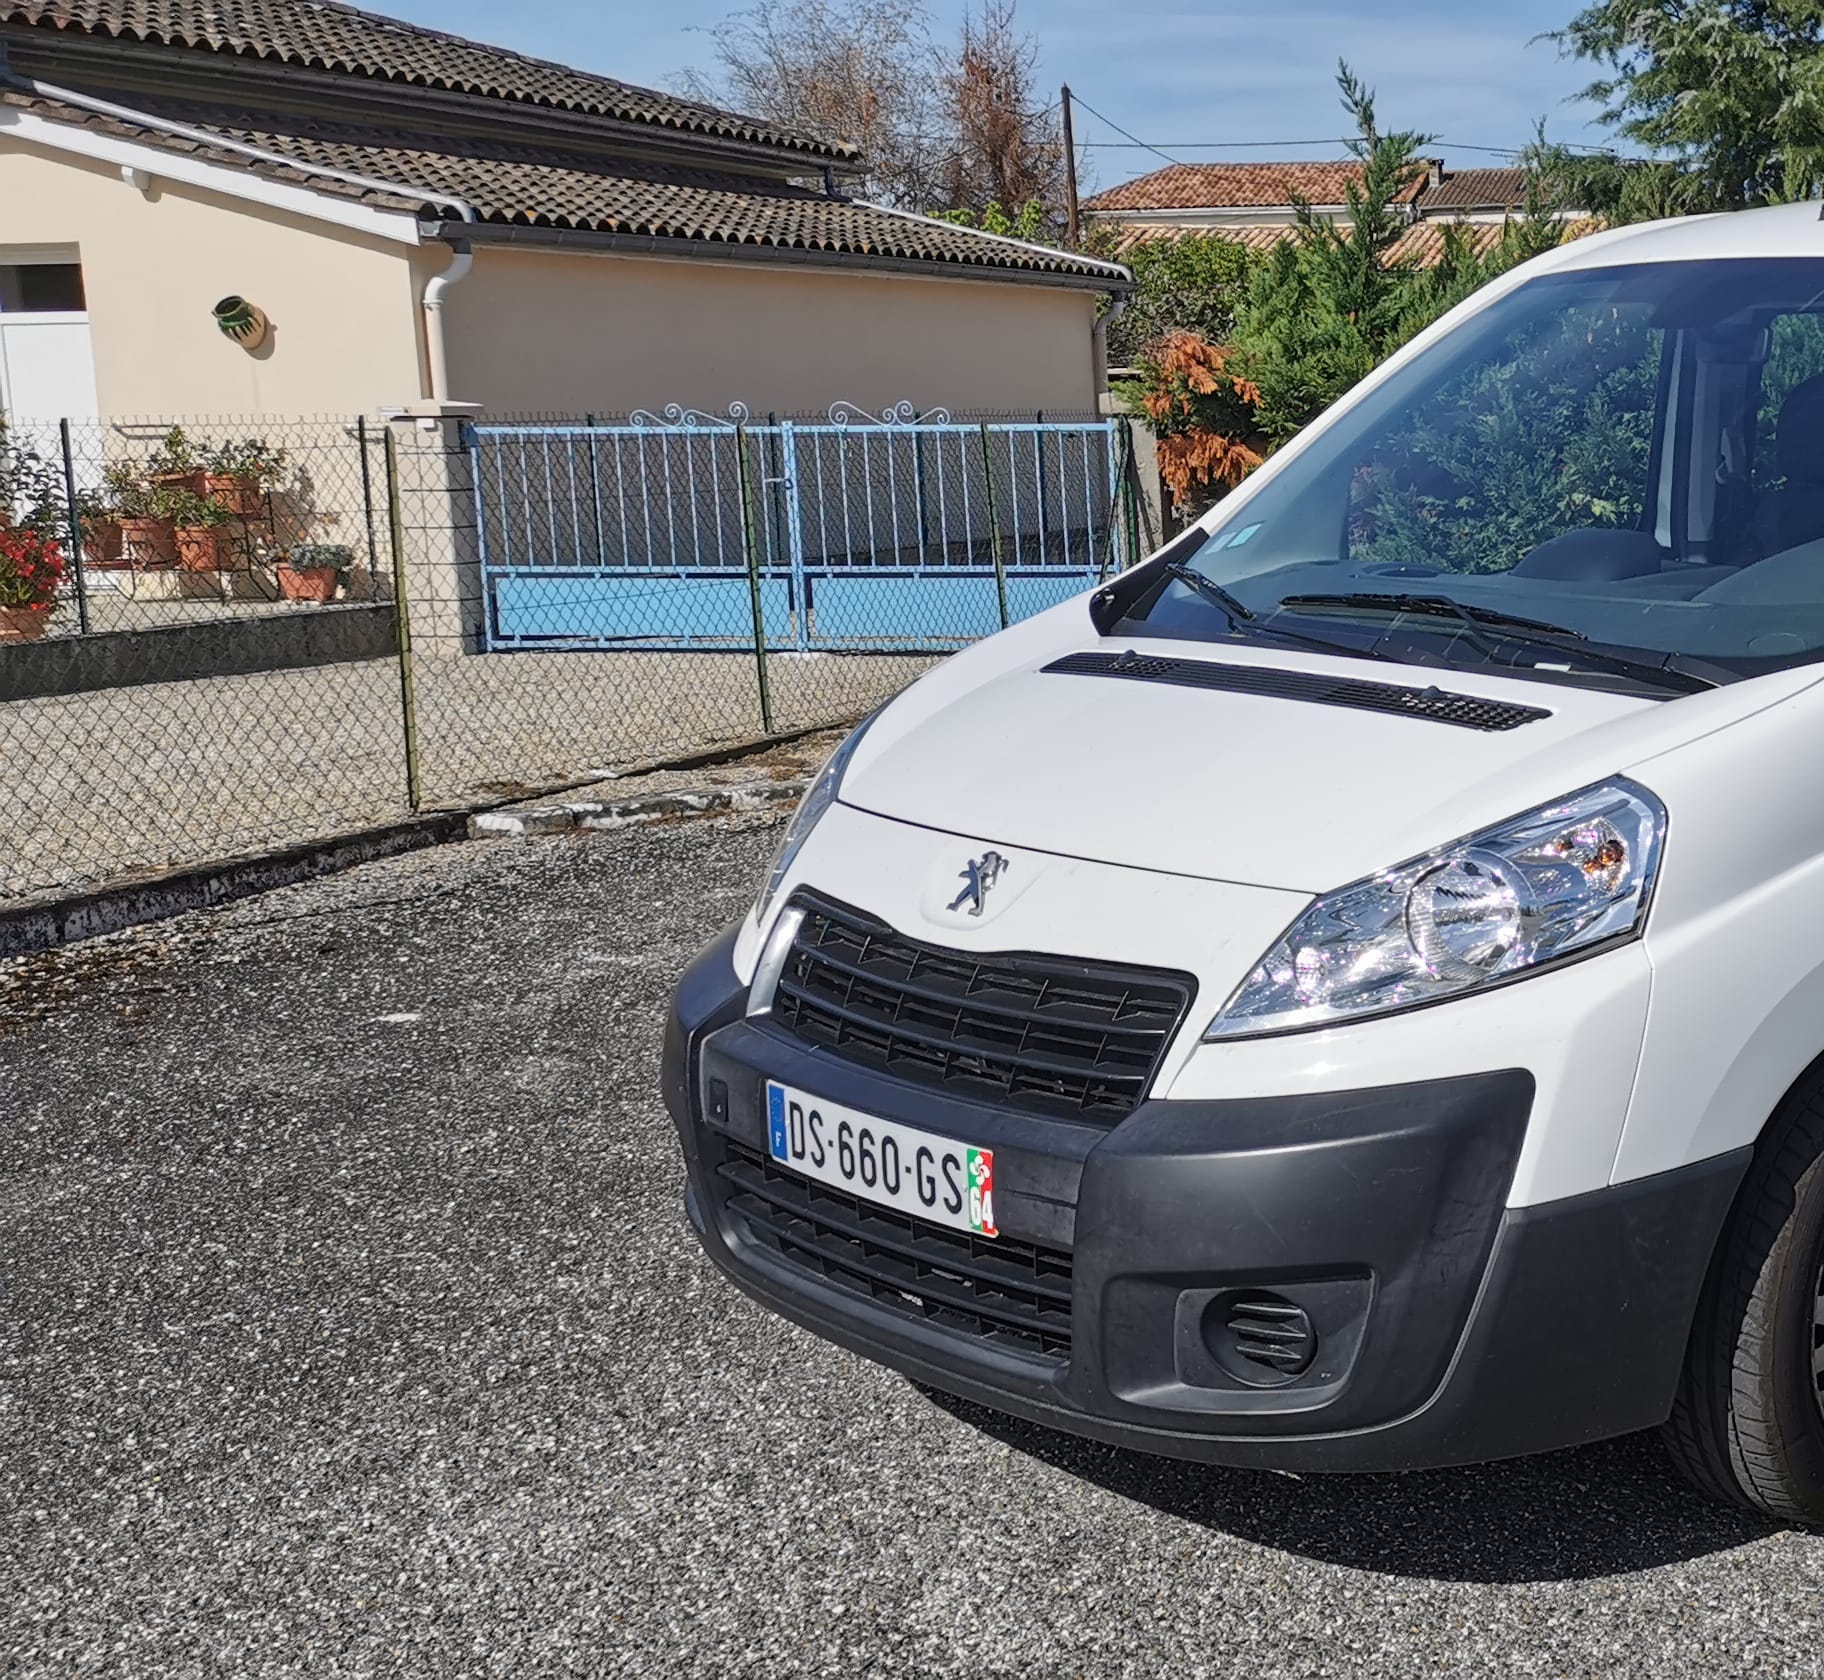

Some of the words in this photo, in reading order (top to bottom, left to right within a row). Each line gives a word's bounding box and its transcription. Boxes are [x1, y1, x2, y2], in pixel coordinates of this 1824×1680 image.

[776, 1131, 782, 1147] F
[789, 1101, 963, 1214] DS-660-GS
[969, 1186, 995, 1229] 64
